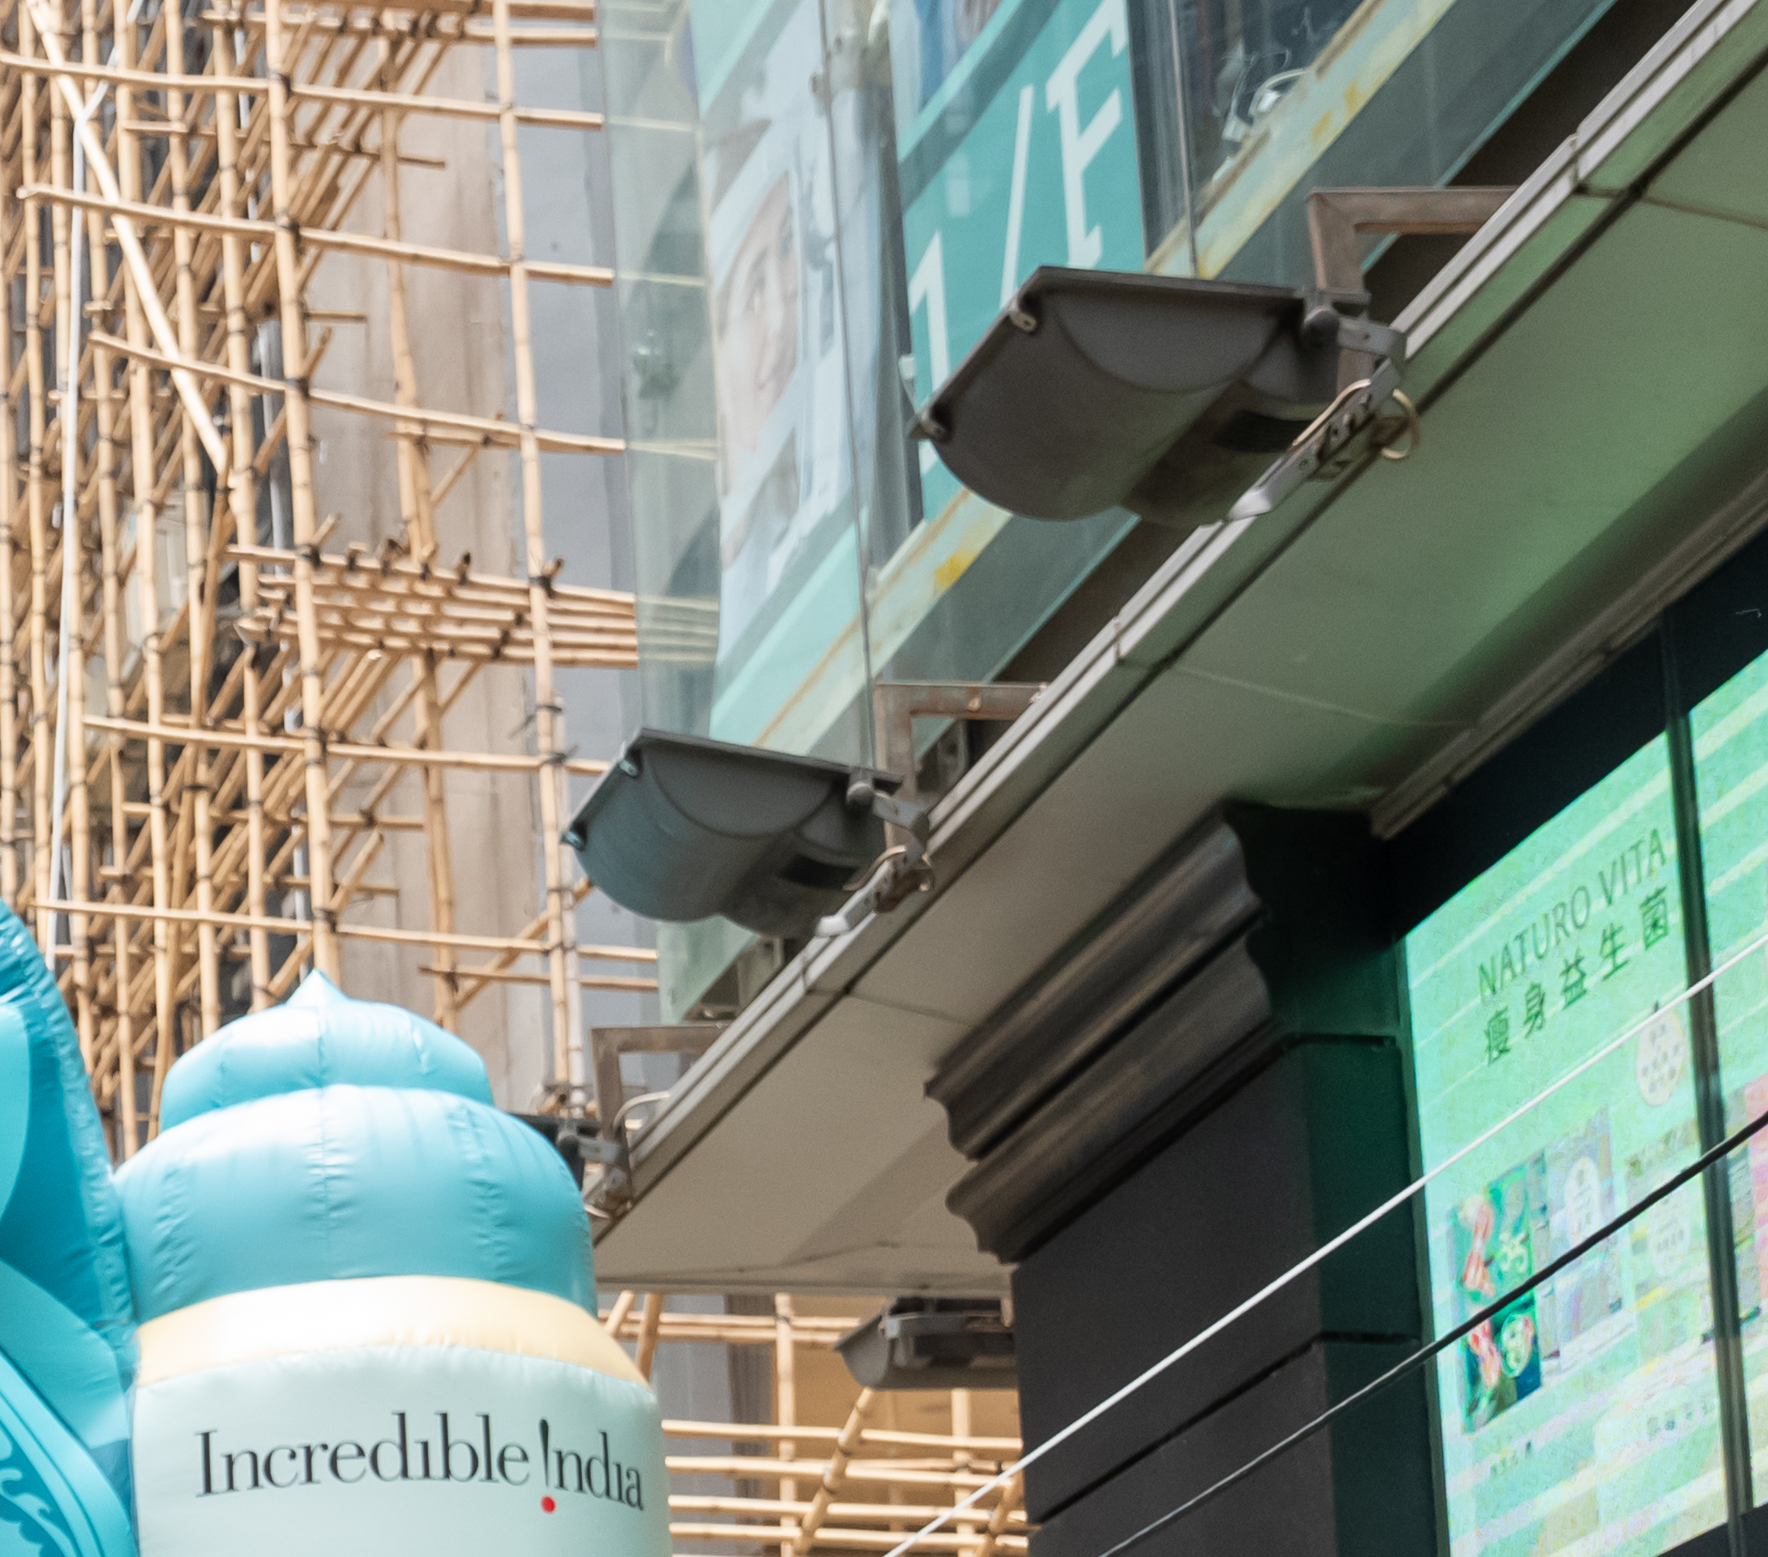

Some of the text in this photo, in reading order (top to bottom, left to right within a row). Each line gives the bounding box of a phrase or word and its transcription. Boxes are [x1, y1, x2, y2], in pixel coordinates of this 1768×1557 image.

[1478, 827, 1666, 997] NATURO VITA
[1484, 886, 1669, 1068] 瘦身益生菌
